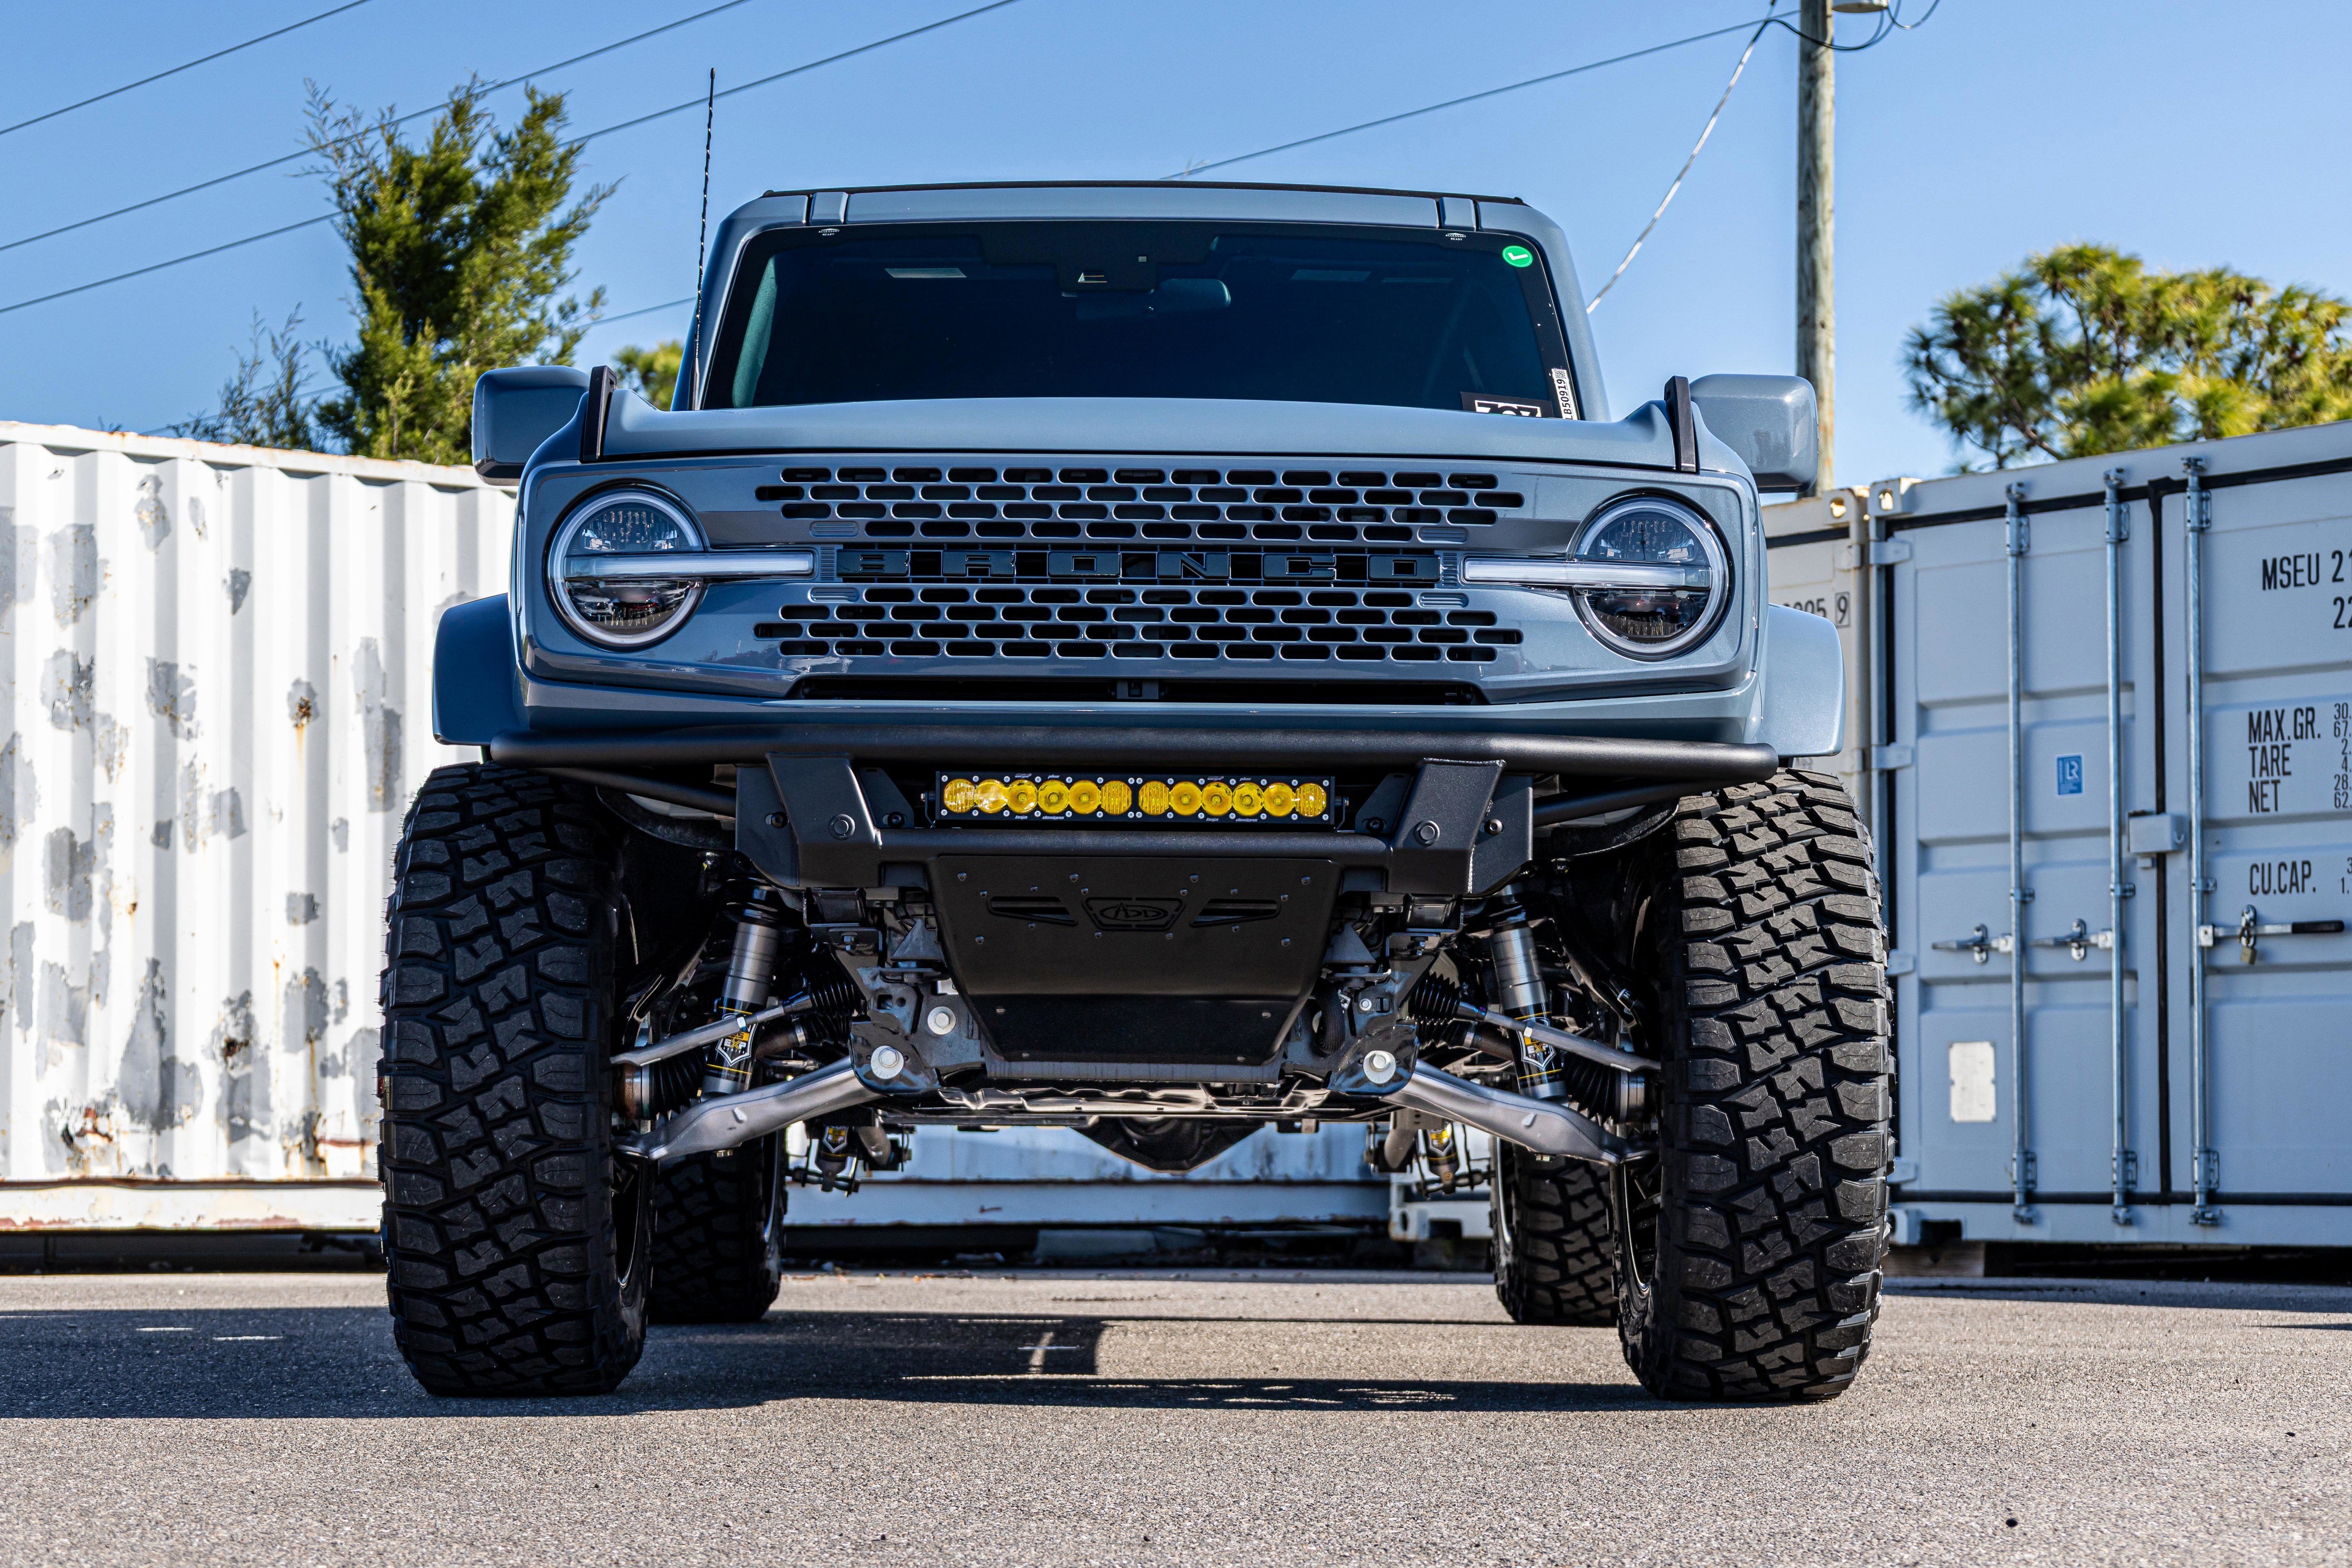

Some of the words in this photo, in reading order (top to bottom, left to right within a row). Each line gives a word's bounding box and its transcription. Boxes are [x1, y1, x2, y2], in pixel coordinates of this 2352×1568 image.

[836, 549, 1442, 582] BRONCO
[2262, 552, 2321, 590] MSEU
[2331, 548, 2352, 582] 2
[1838, 596, 1847, 624] 9
[2248, 706, 2321, 744] MAX.GR.
[2249, 743, 2292, 778] TARE
[2249, 779, 2281, 813] NET
[2249, 860, 2316, 895] CU.CAP.
[724, 1038, 747, 1049] EXP
[1527, 1042, 1549, 1054] EXP
